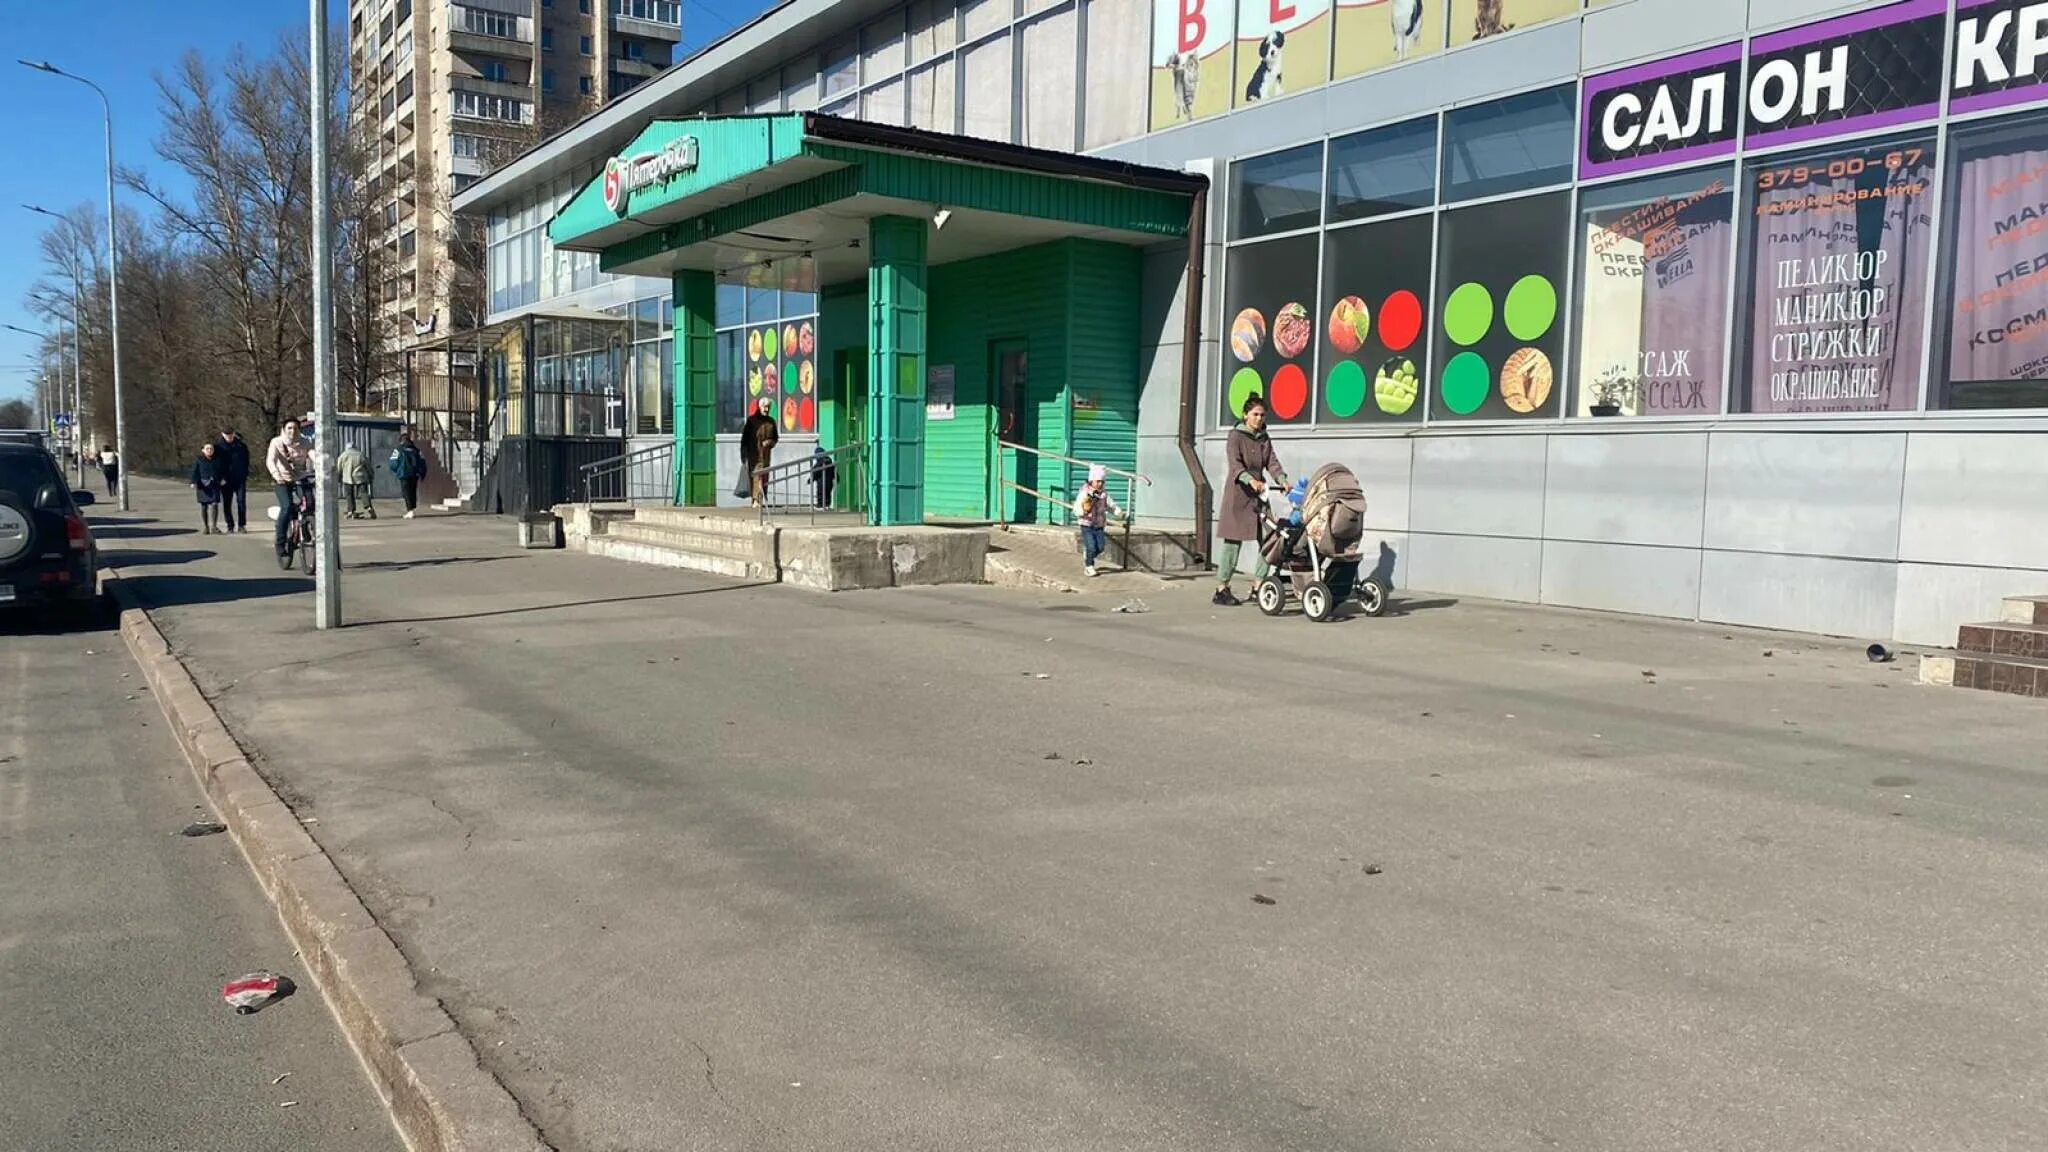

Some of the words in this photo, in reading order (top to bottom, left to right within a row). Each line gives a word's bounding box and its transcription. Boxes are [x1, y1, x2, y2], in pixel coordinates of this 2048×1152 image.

[1602, 45, 1848, 151] САЛОН
[1955, 2, 2048, 89] КР
[1758, 149, 1922, 190] 379-00-67
[1777, 249, 1888, 289] ПЕДИКЮР
[1775, 288, 1885, 326] МАНИКЮР
[1772, 327, 1881, 363] СТРИЖКИ
[1771, 368, 1880, 401] ОКРАШИВАНИЕ
